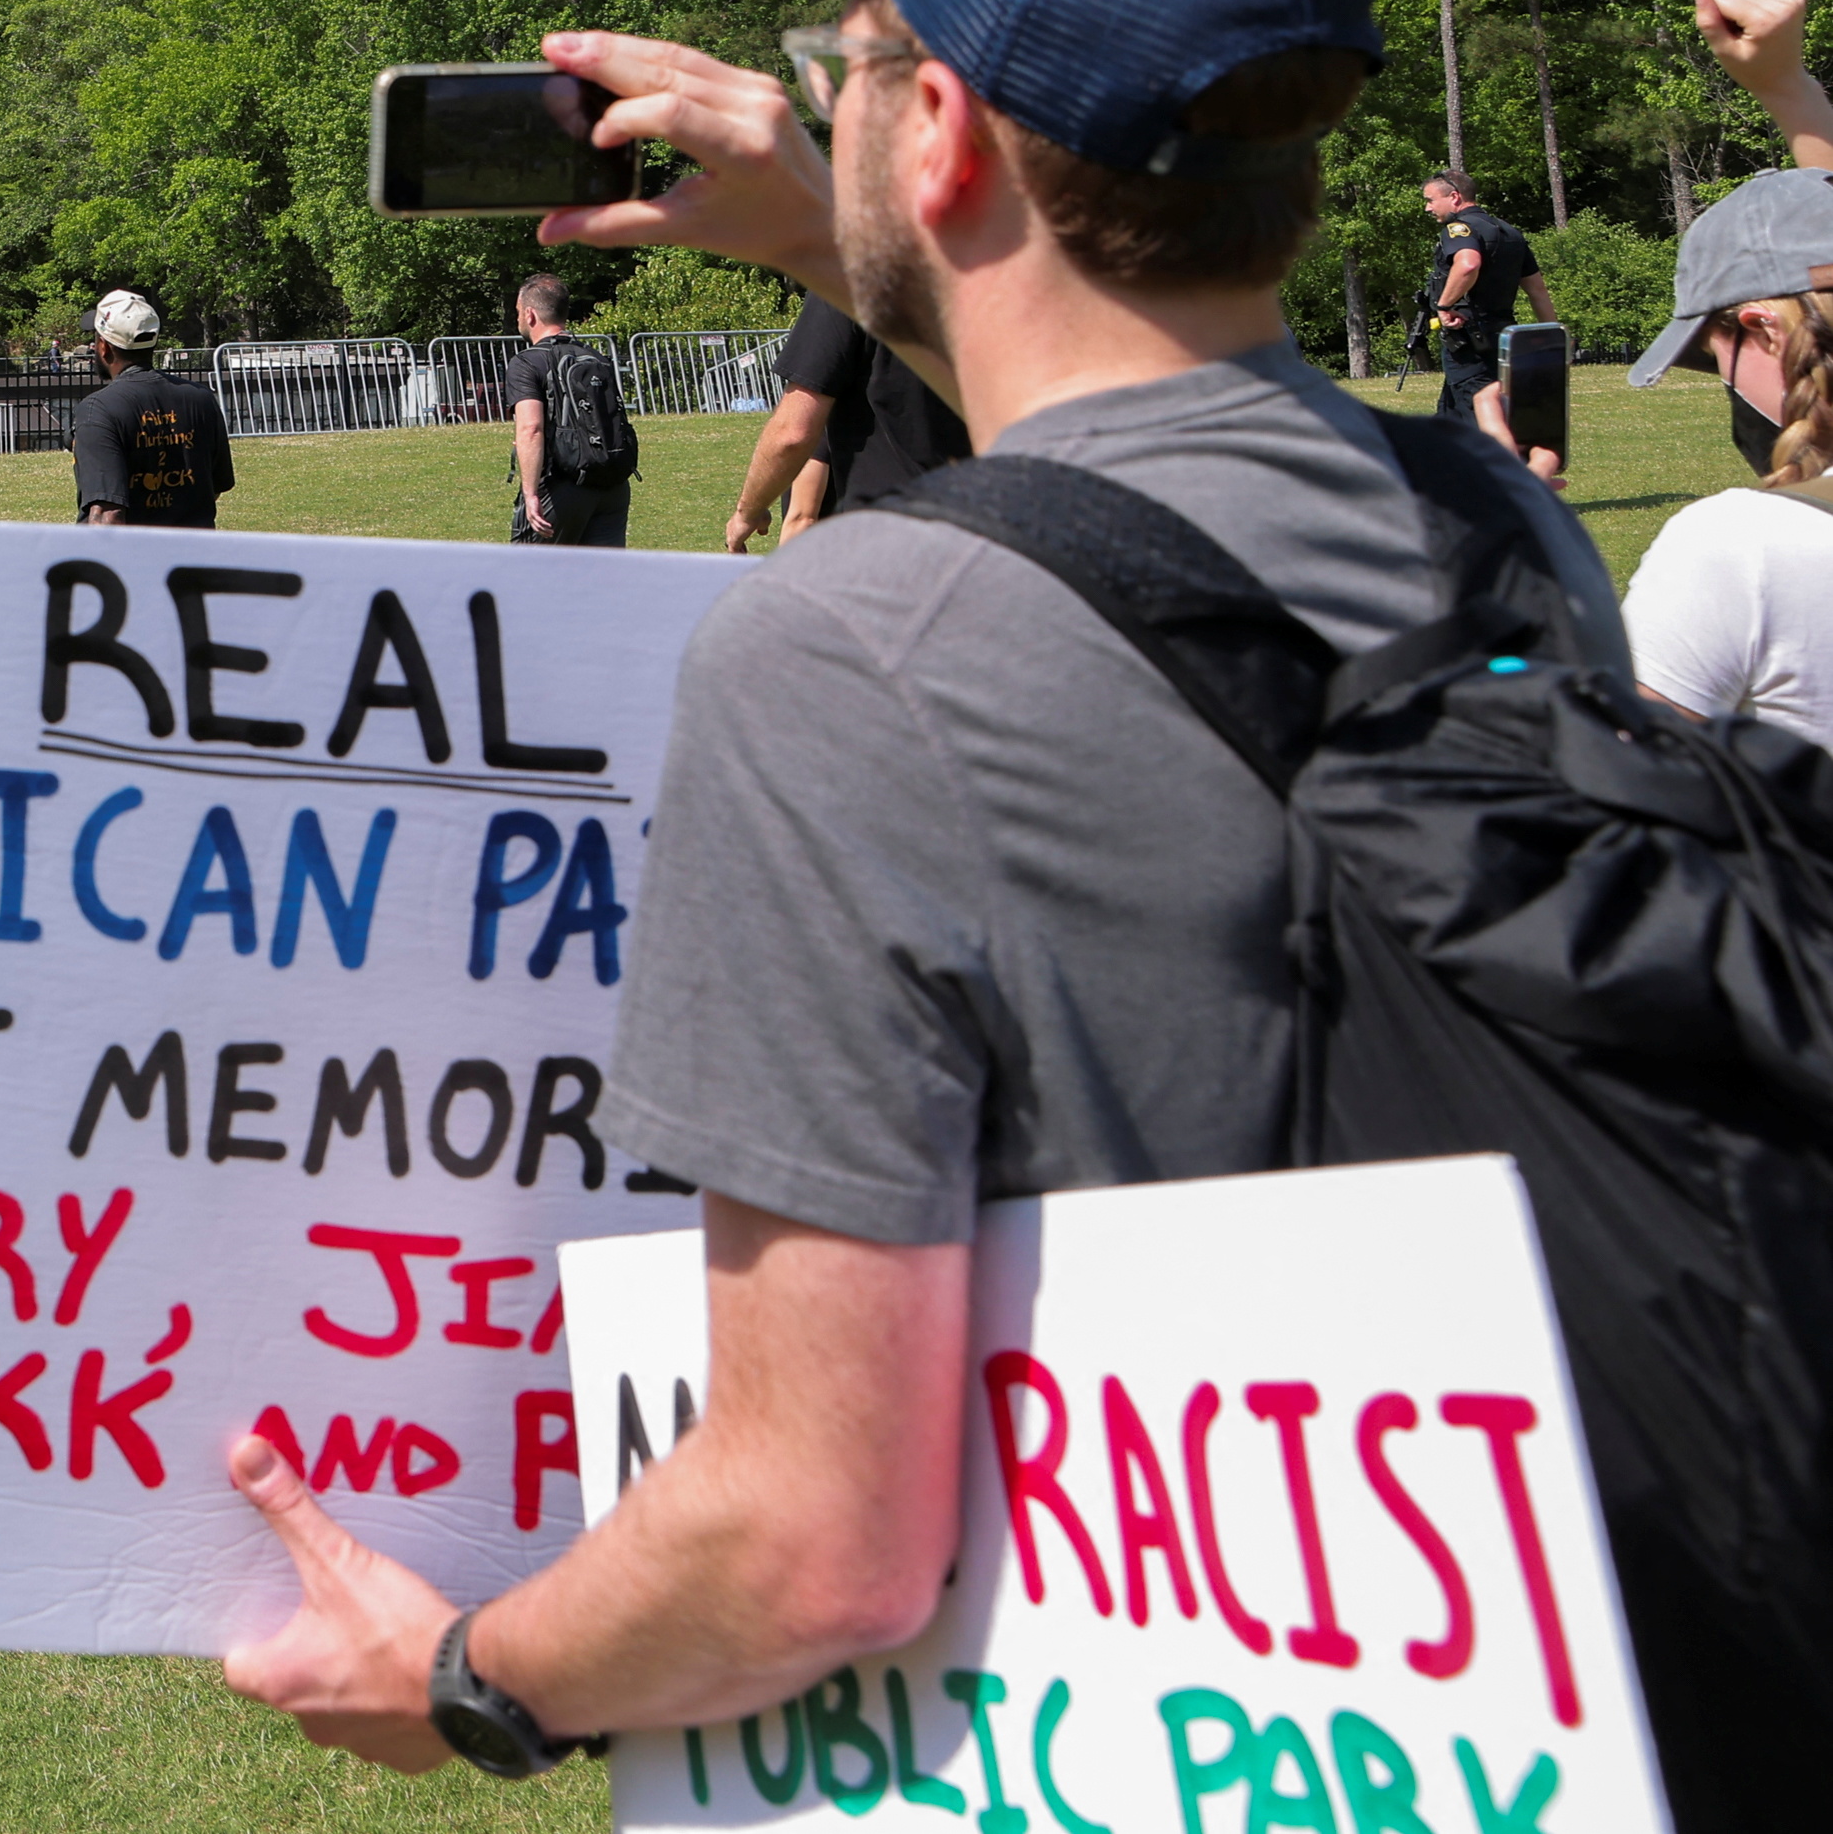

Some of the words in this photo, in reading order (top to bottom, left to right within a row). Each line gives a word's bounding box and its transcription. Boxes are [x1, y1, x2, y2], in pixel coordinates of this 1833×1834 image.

[158, 451, 167, 466] 2
[39, 559, 609, 776] REAL
[466, 809, 653, 986] PA
[68, 1030, 699, 1197] MEMOR
[983, 1349, 1583, 1729] RACIST
[1155, 1686, 1563, 1834] PARK
